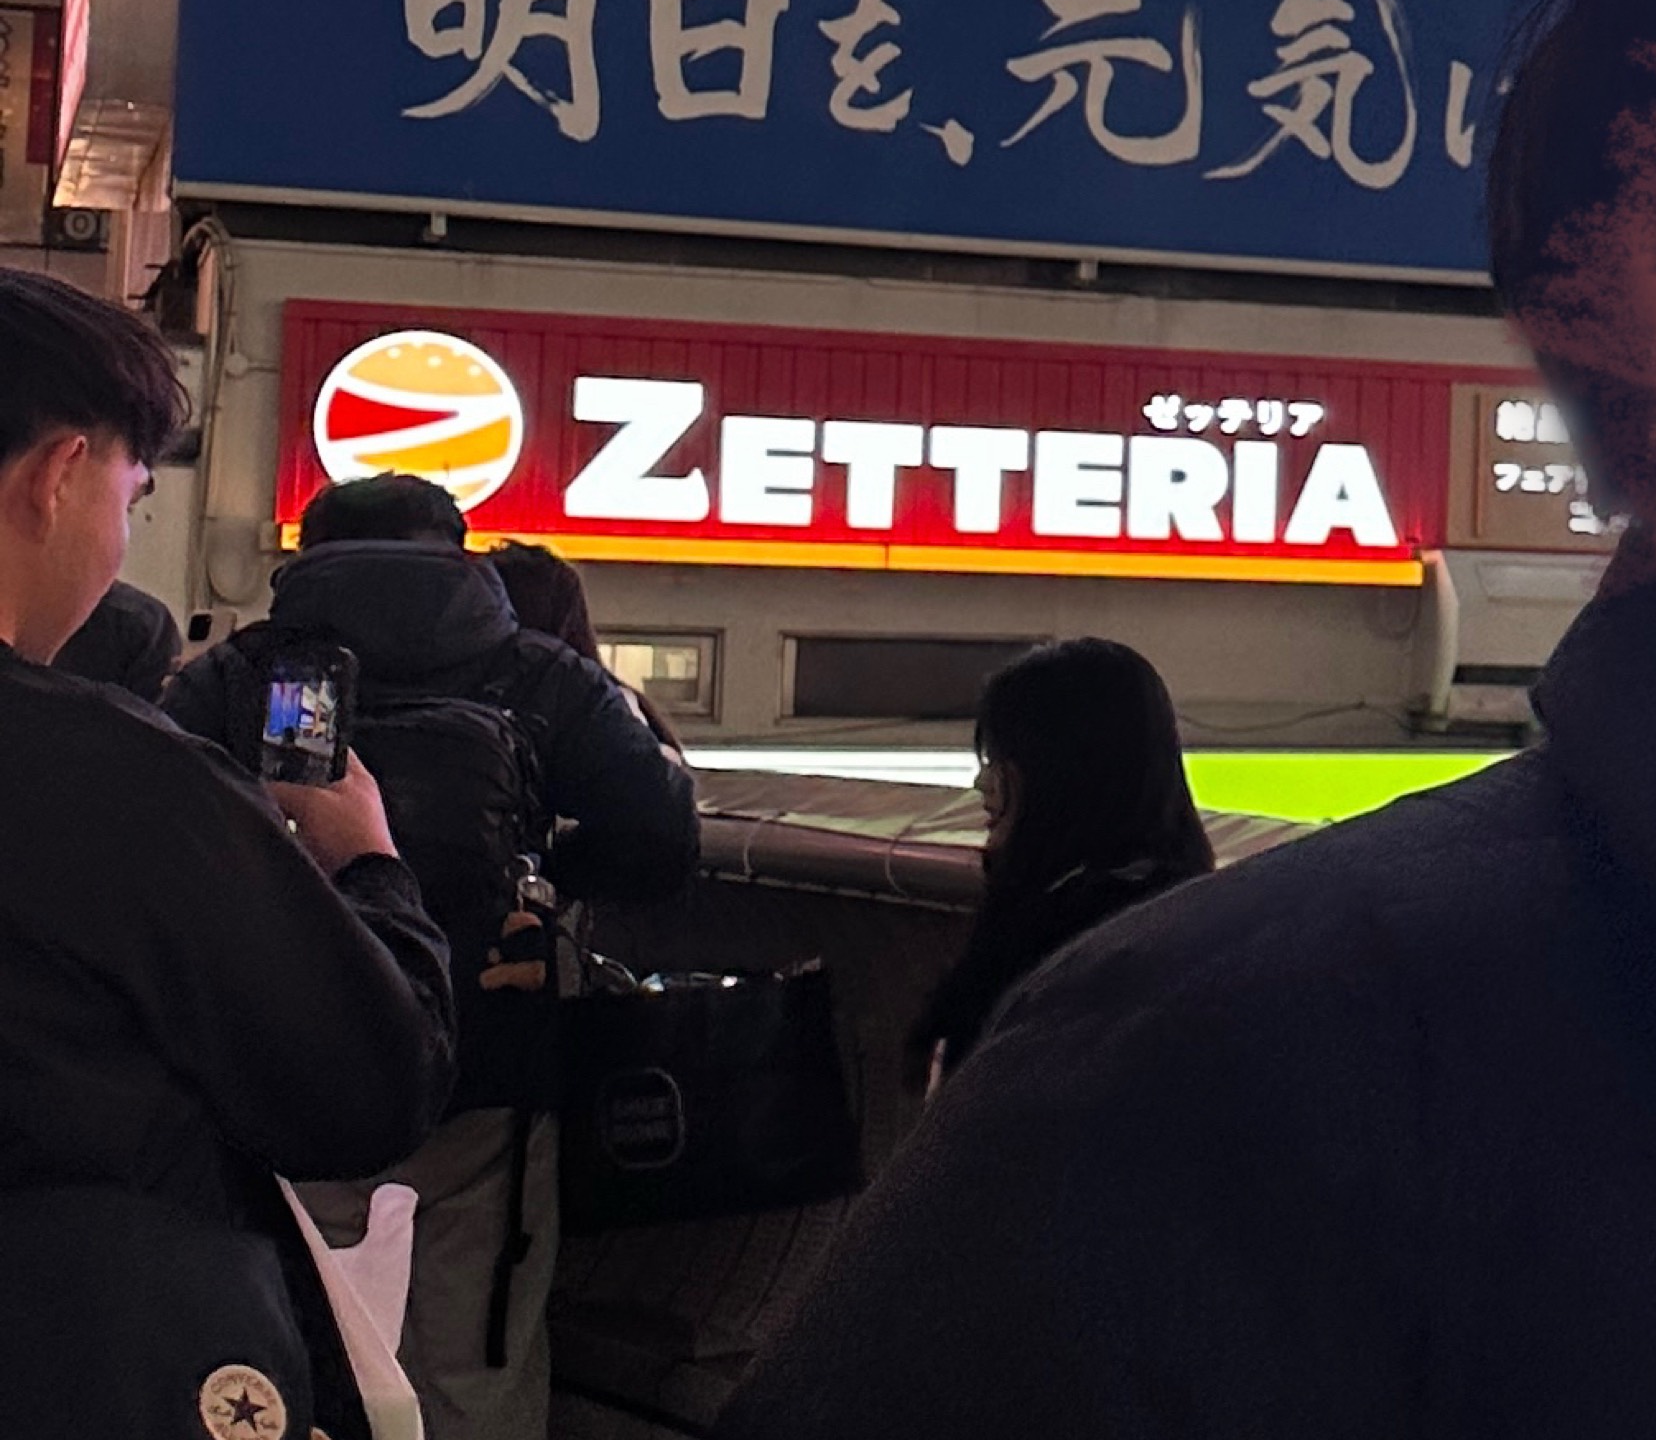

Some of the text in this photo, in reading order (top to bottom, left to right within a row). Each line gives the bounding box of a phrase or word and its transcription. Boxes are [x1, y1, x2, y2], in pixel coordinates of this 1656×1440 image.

[564, 376, 1399, 546] ZETTERIA
[1143, 394, 1324, 437] ゼッテリア
